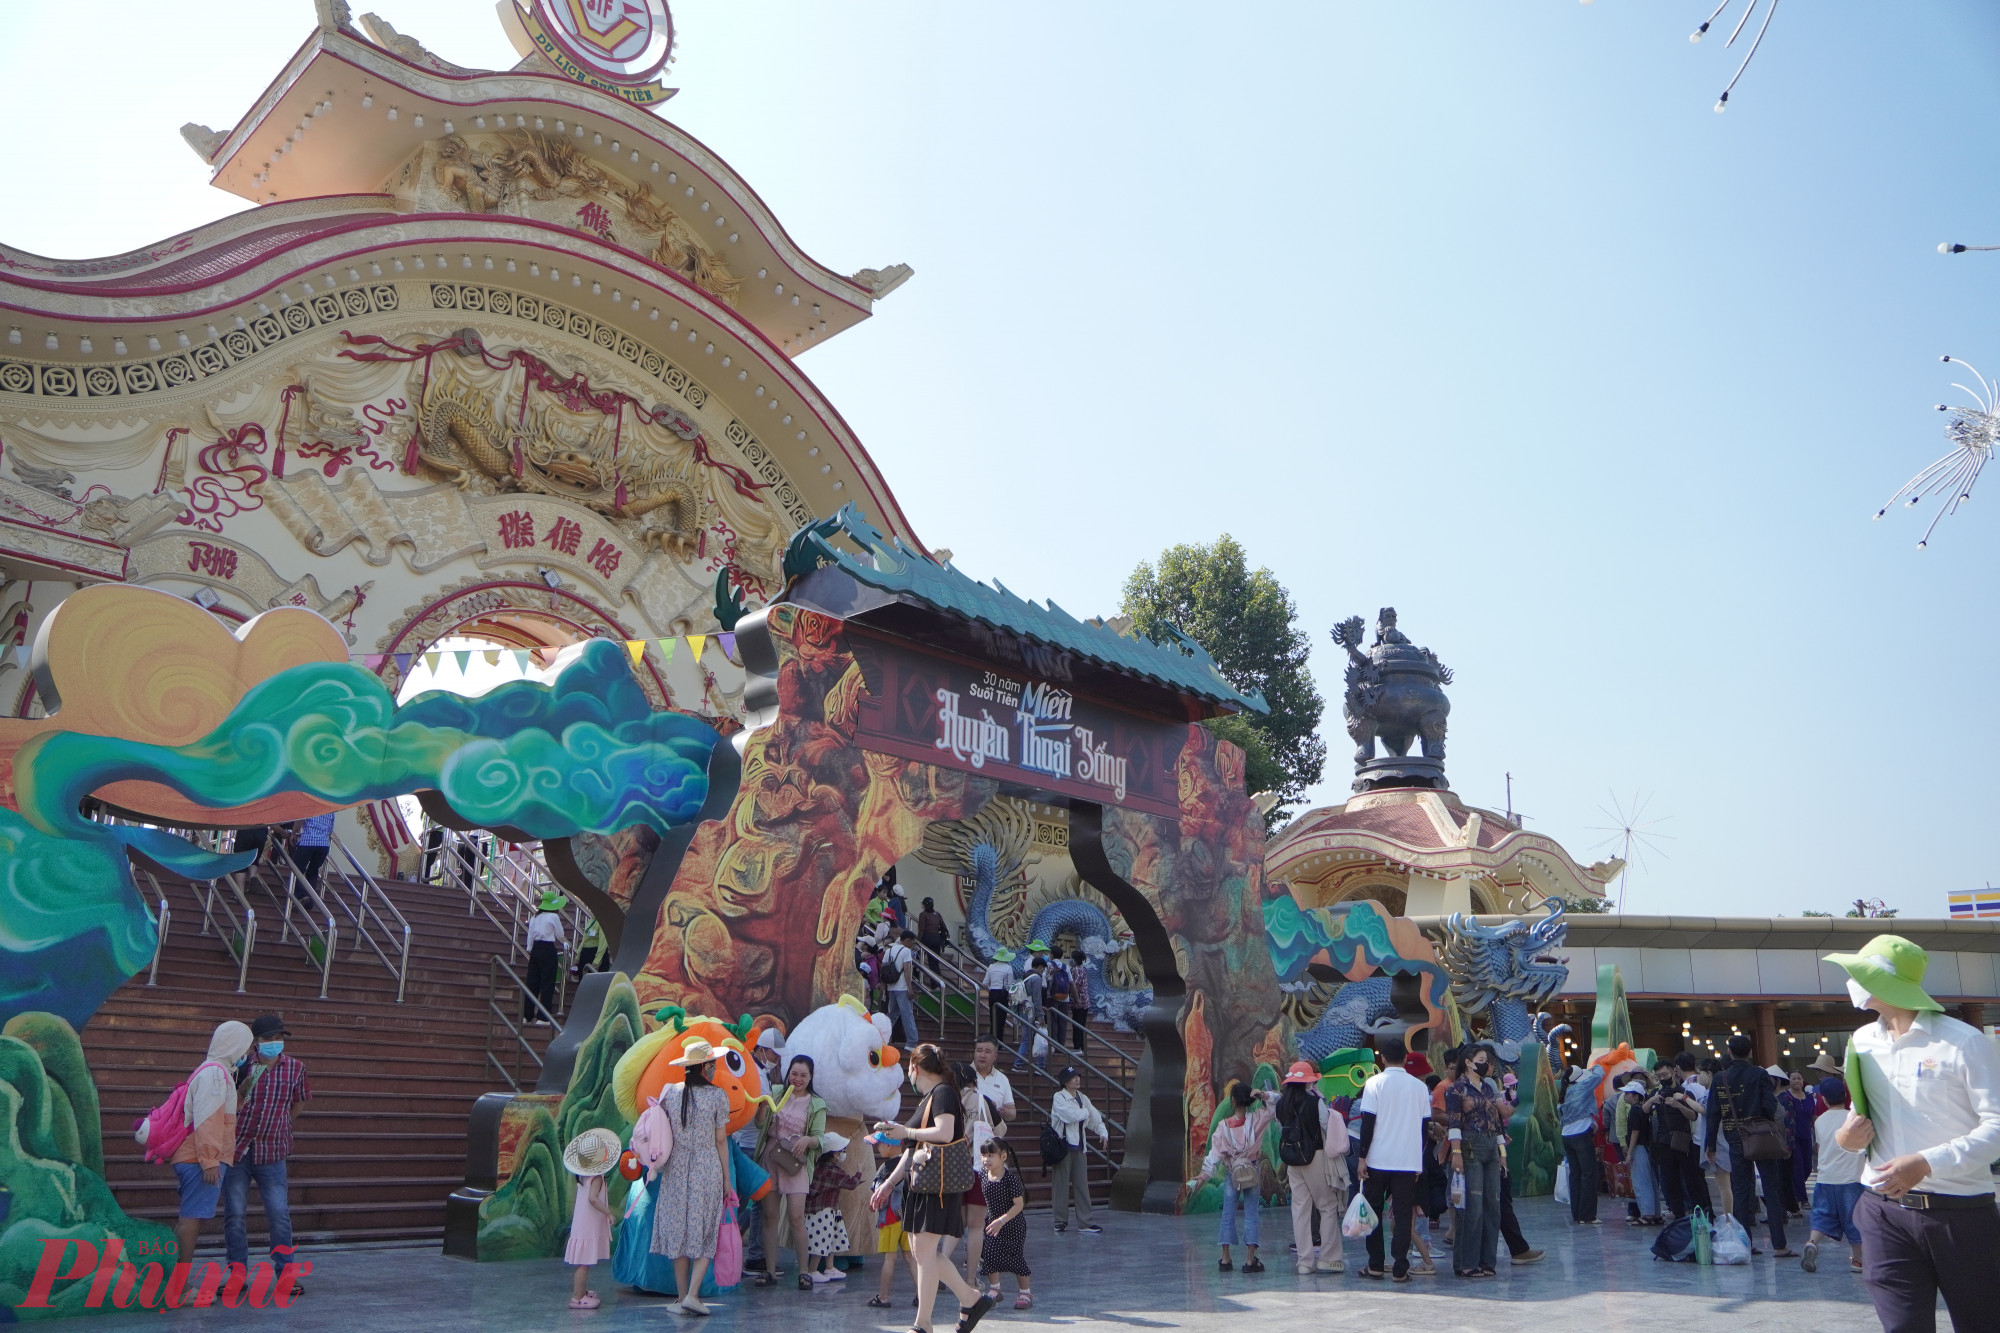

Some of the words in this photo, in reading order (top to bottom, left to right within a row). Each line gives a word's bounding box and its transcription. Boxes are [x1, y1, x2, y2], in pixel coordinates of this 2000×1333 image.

[536, 33, 555, 53] DU
[554, 54, 586, 82] LỊCH
[623, 88, 653, 101] TIÊN
[983, 671, 997, 686] 30
[998, 678, 1021, 694] năm
[996, 689, 1019, 708] Tiên
[1021, 681, 1074, 720] Miền
[935, 688, 1010, 769] Huyền
[1015, 710, 1072, 779] Thoại
[1074, 726, 1128, 801] Sống
